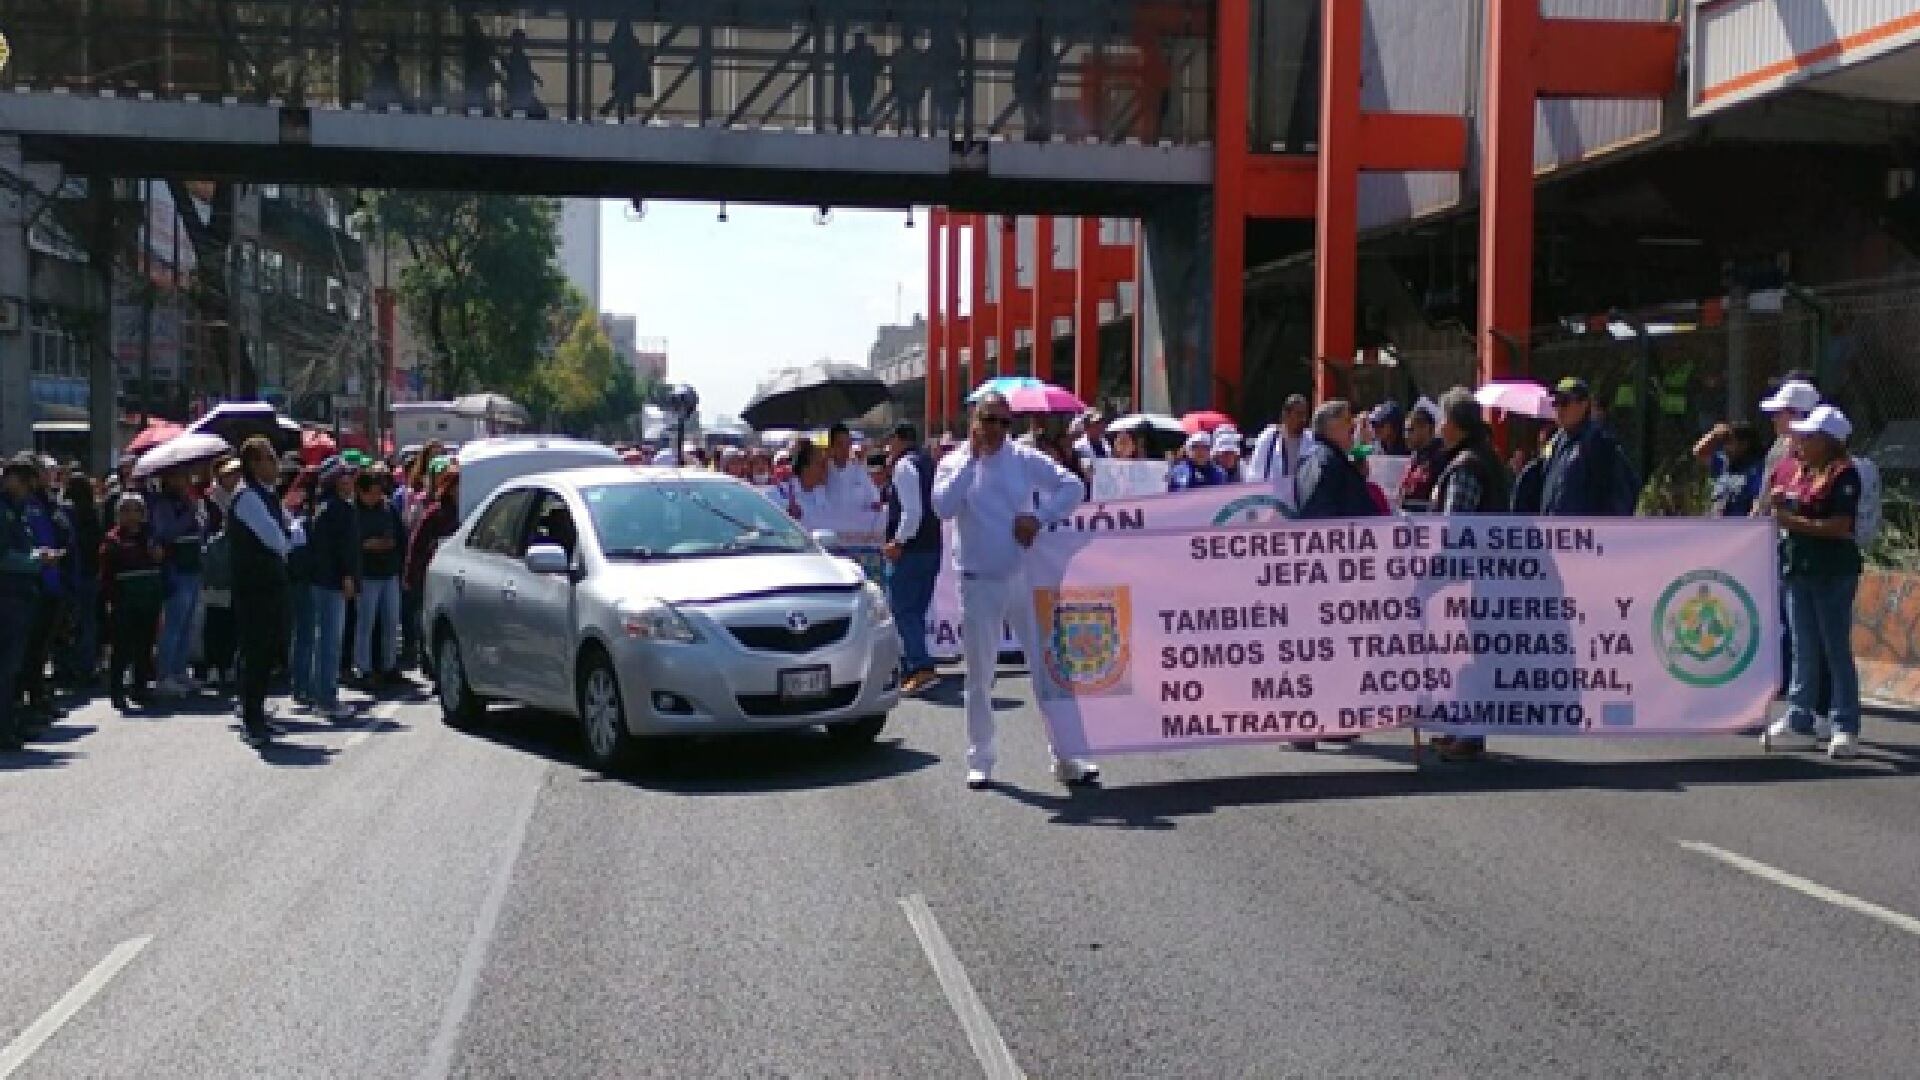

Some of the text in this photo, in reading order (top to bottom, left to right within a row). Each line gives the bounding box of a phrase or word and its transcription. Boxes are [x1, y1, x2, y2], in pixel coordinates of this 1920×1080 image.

[1190, 523, 1604, 560] SECRETARÍA DE LA SEBIEN,
[1255, 554, 1547, 587] JEFA DE GOBIERNO.
[1158, 596, 1633, 635] TAMBIÉN SOMOS MUJERES, Y
[1161, 631, 1634, 670] SOMOS SUS TRABAJADORAS. ¡YA
[1161, 667, 1633, 702] NO MÁS ACOSO LABORAL,
[1161, 710, 1326, 739] MALTRATO,
